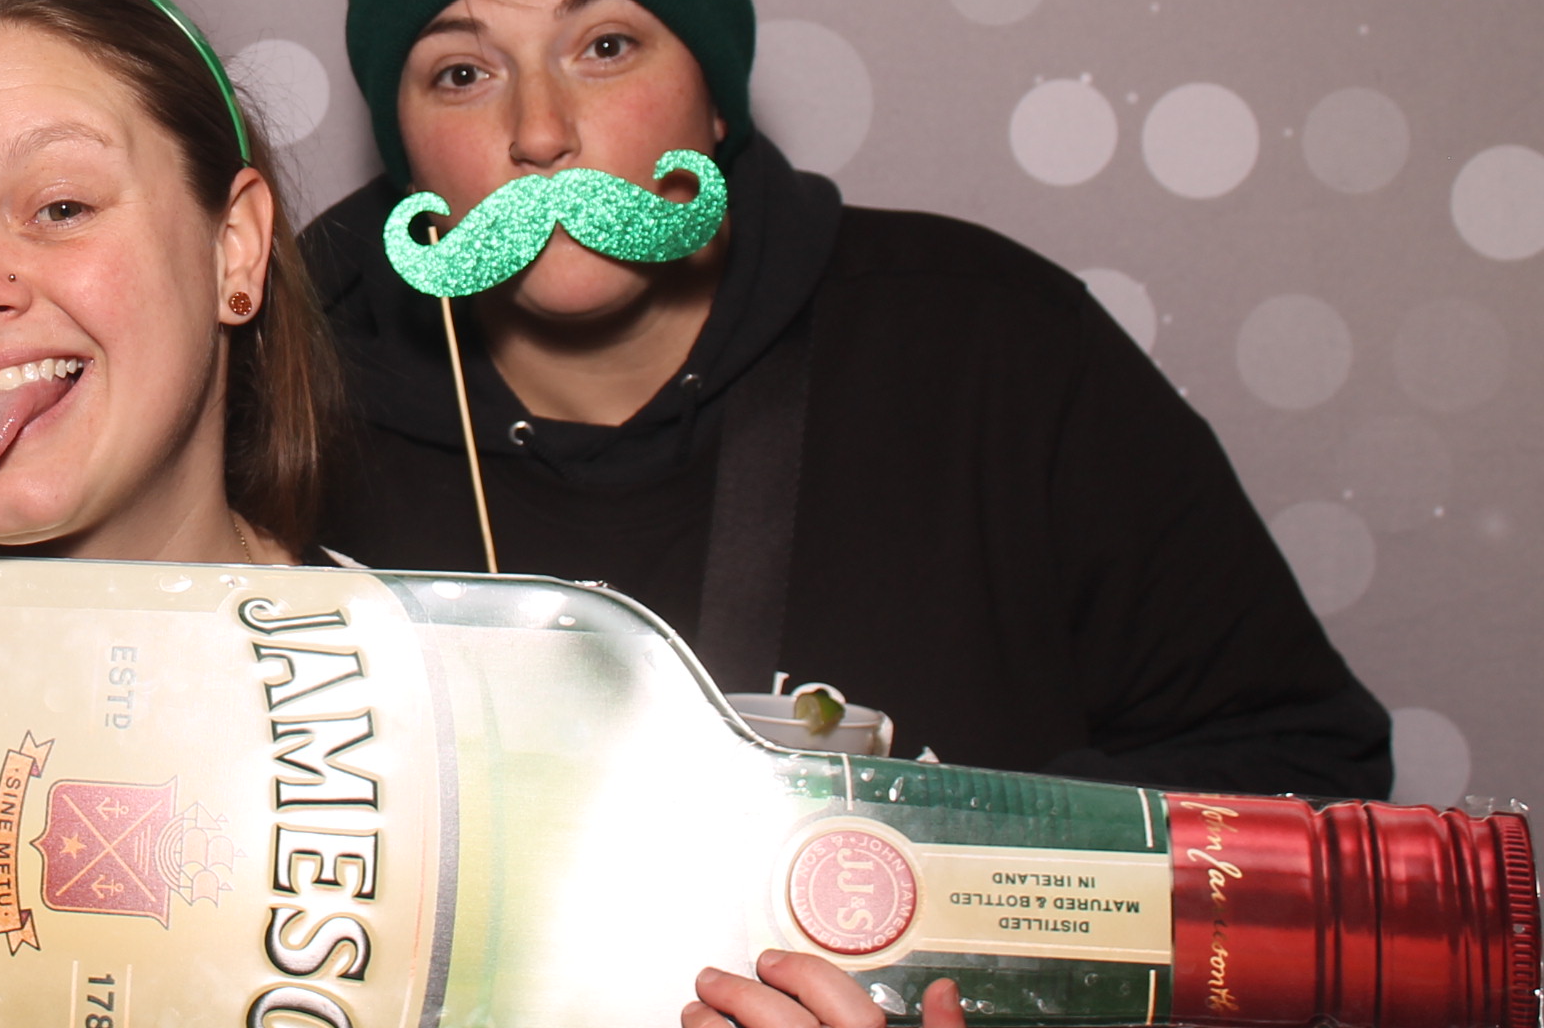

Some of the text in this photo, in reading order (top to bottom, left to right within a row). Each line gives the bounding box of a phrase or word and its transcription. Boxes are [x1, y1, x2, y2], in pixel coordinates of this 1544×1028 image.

[992, 872, 1095, 888] IN IRELAND
[858, 836, 914, 951] JOHN JAMESON
[949, 892, 1140, 913] MATURED & BOTTLED
[998, 917, 1090, 933] DISTILLED
